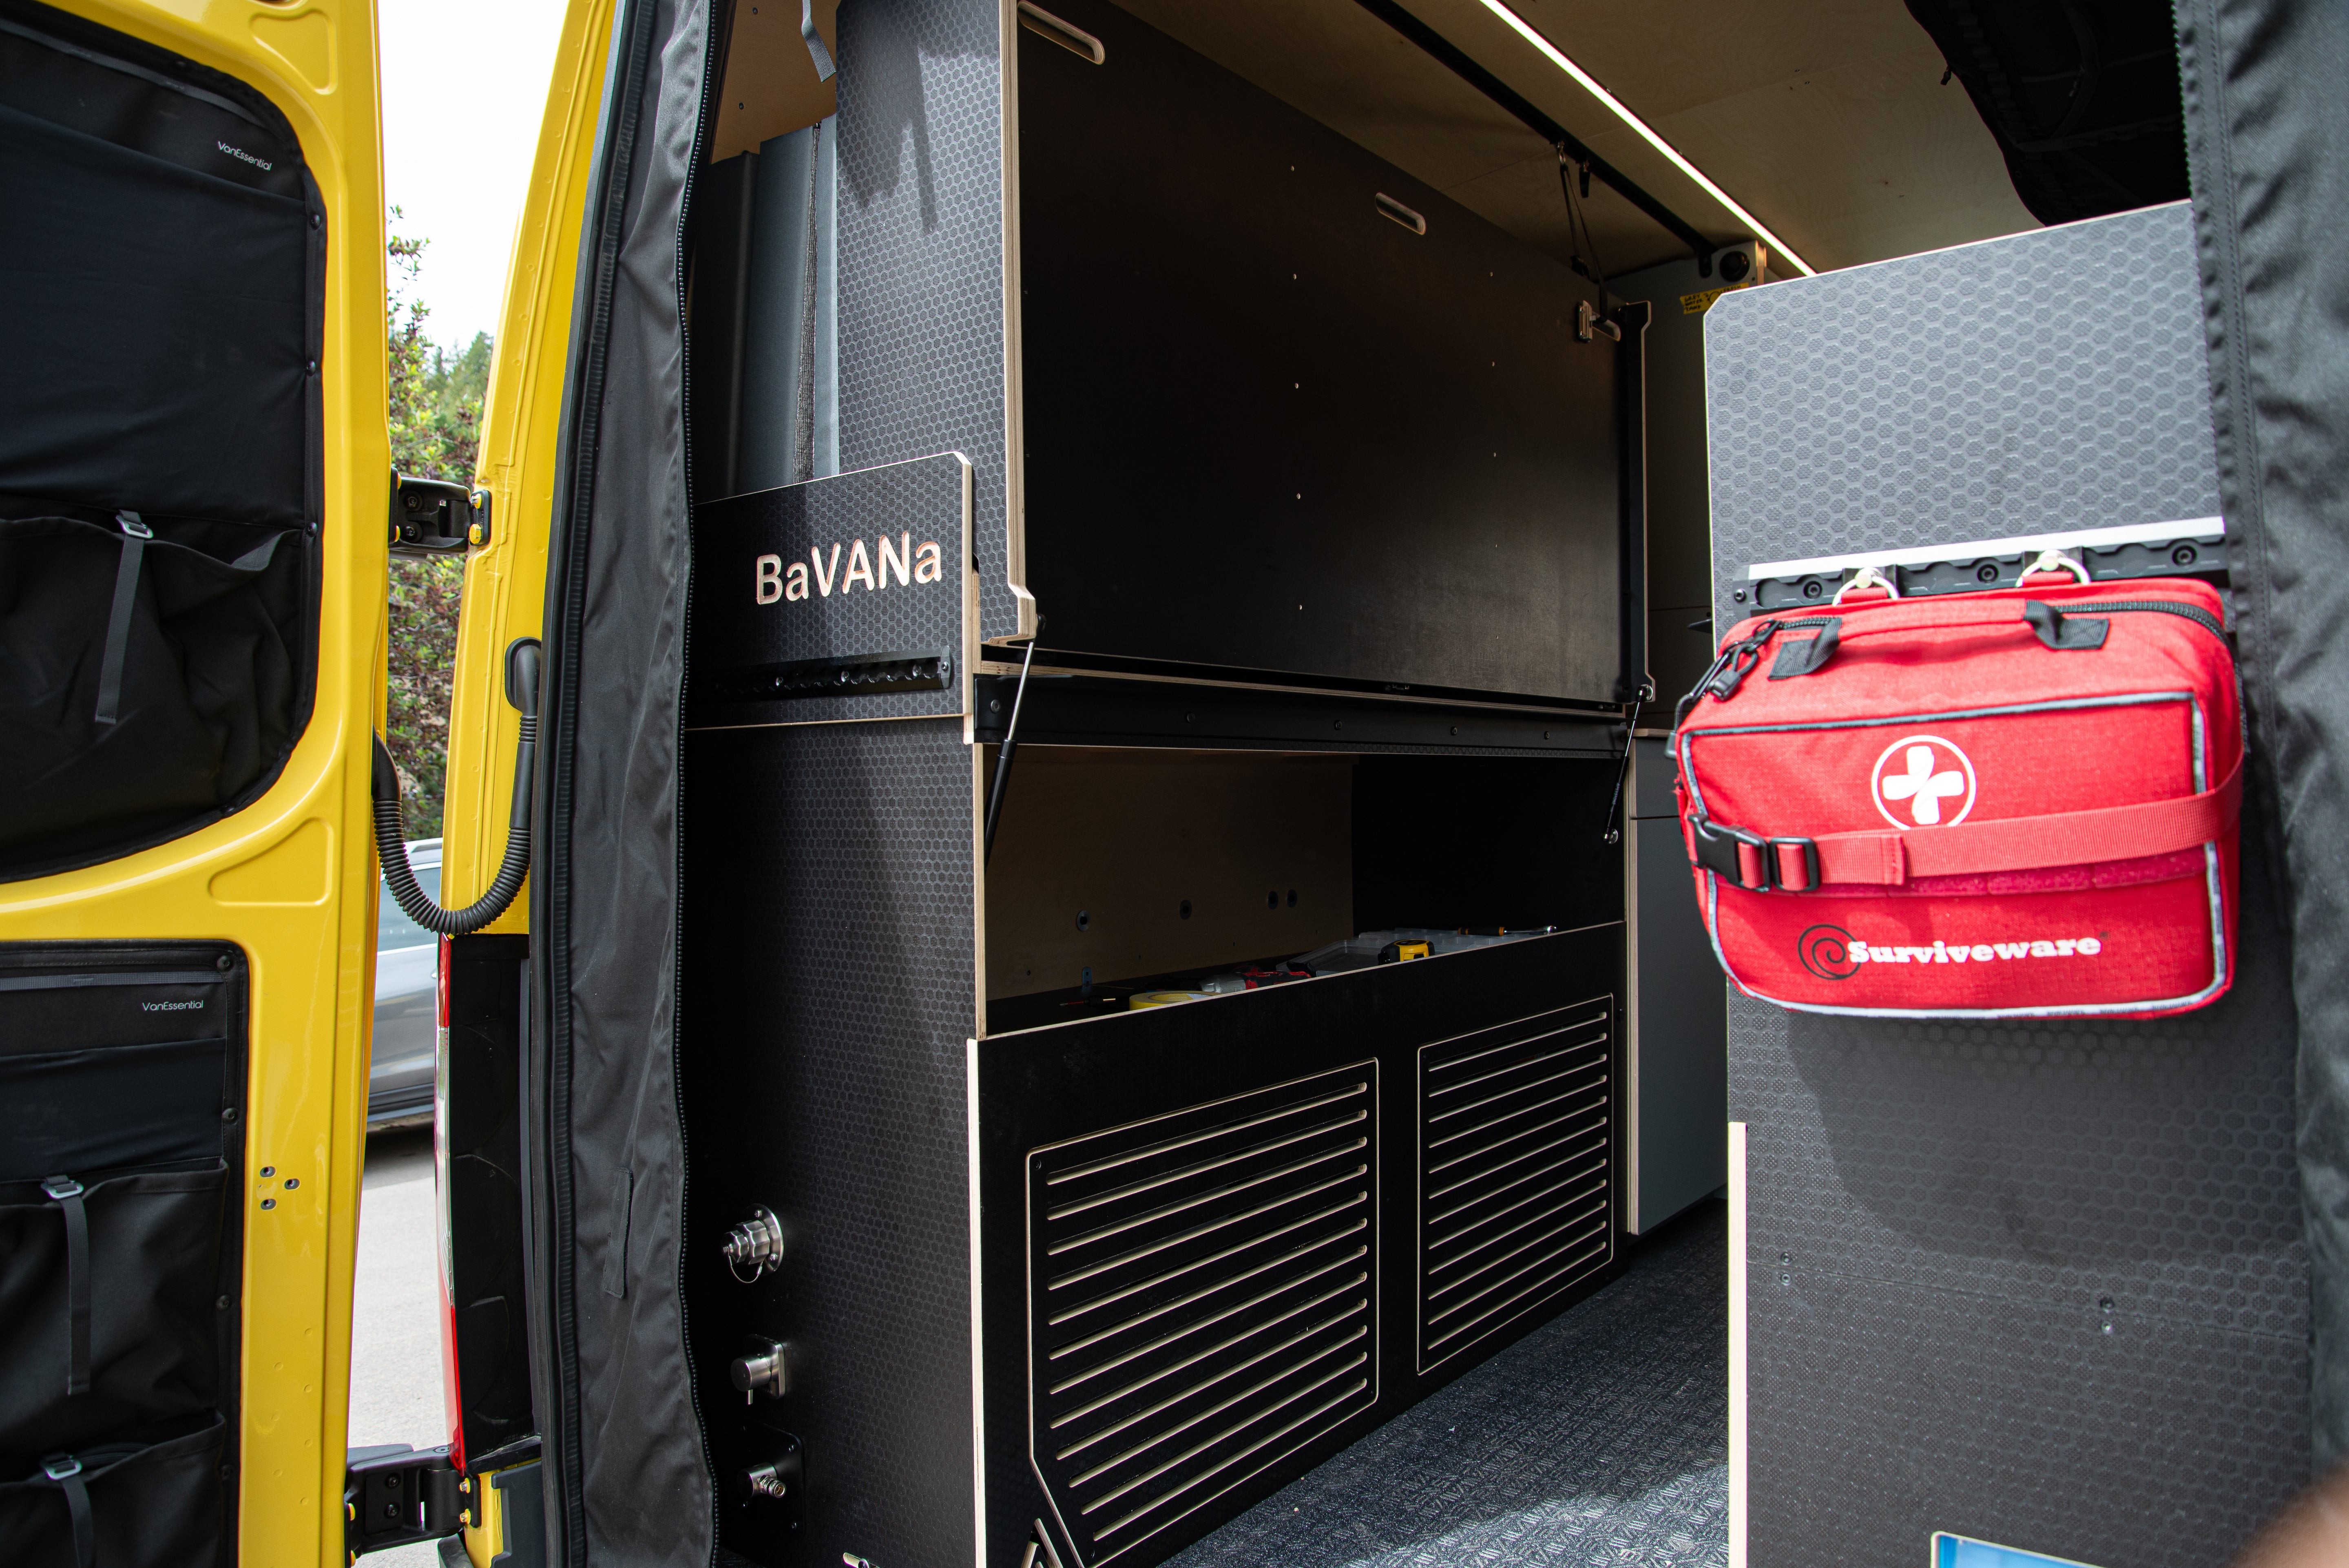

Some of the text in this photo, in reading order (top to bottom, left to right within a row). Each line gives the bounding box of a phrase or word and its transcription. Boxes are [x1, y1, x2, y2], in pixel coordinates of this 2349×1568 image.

[218, 141, 272, 171] VanEssential
[756, 531, 942, 605] BaVANa
[1847, 937, 2102, 963] Surviveware
[142, 1000, 203, 1011] VanEssential
